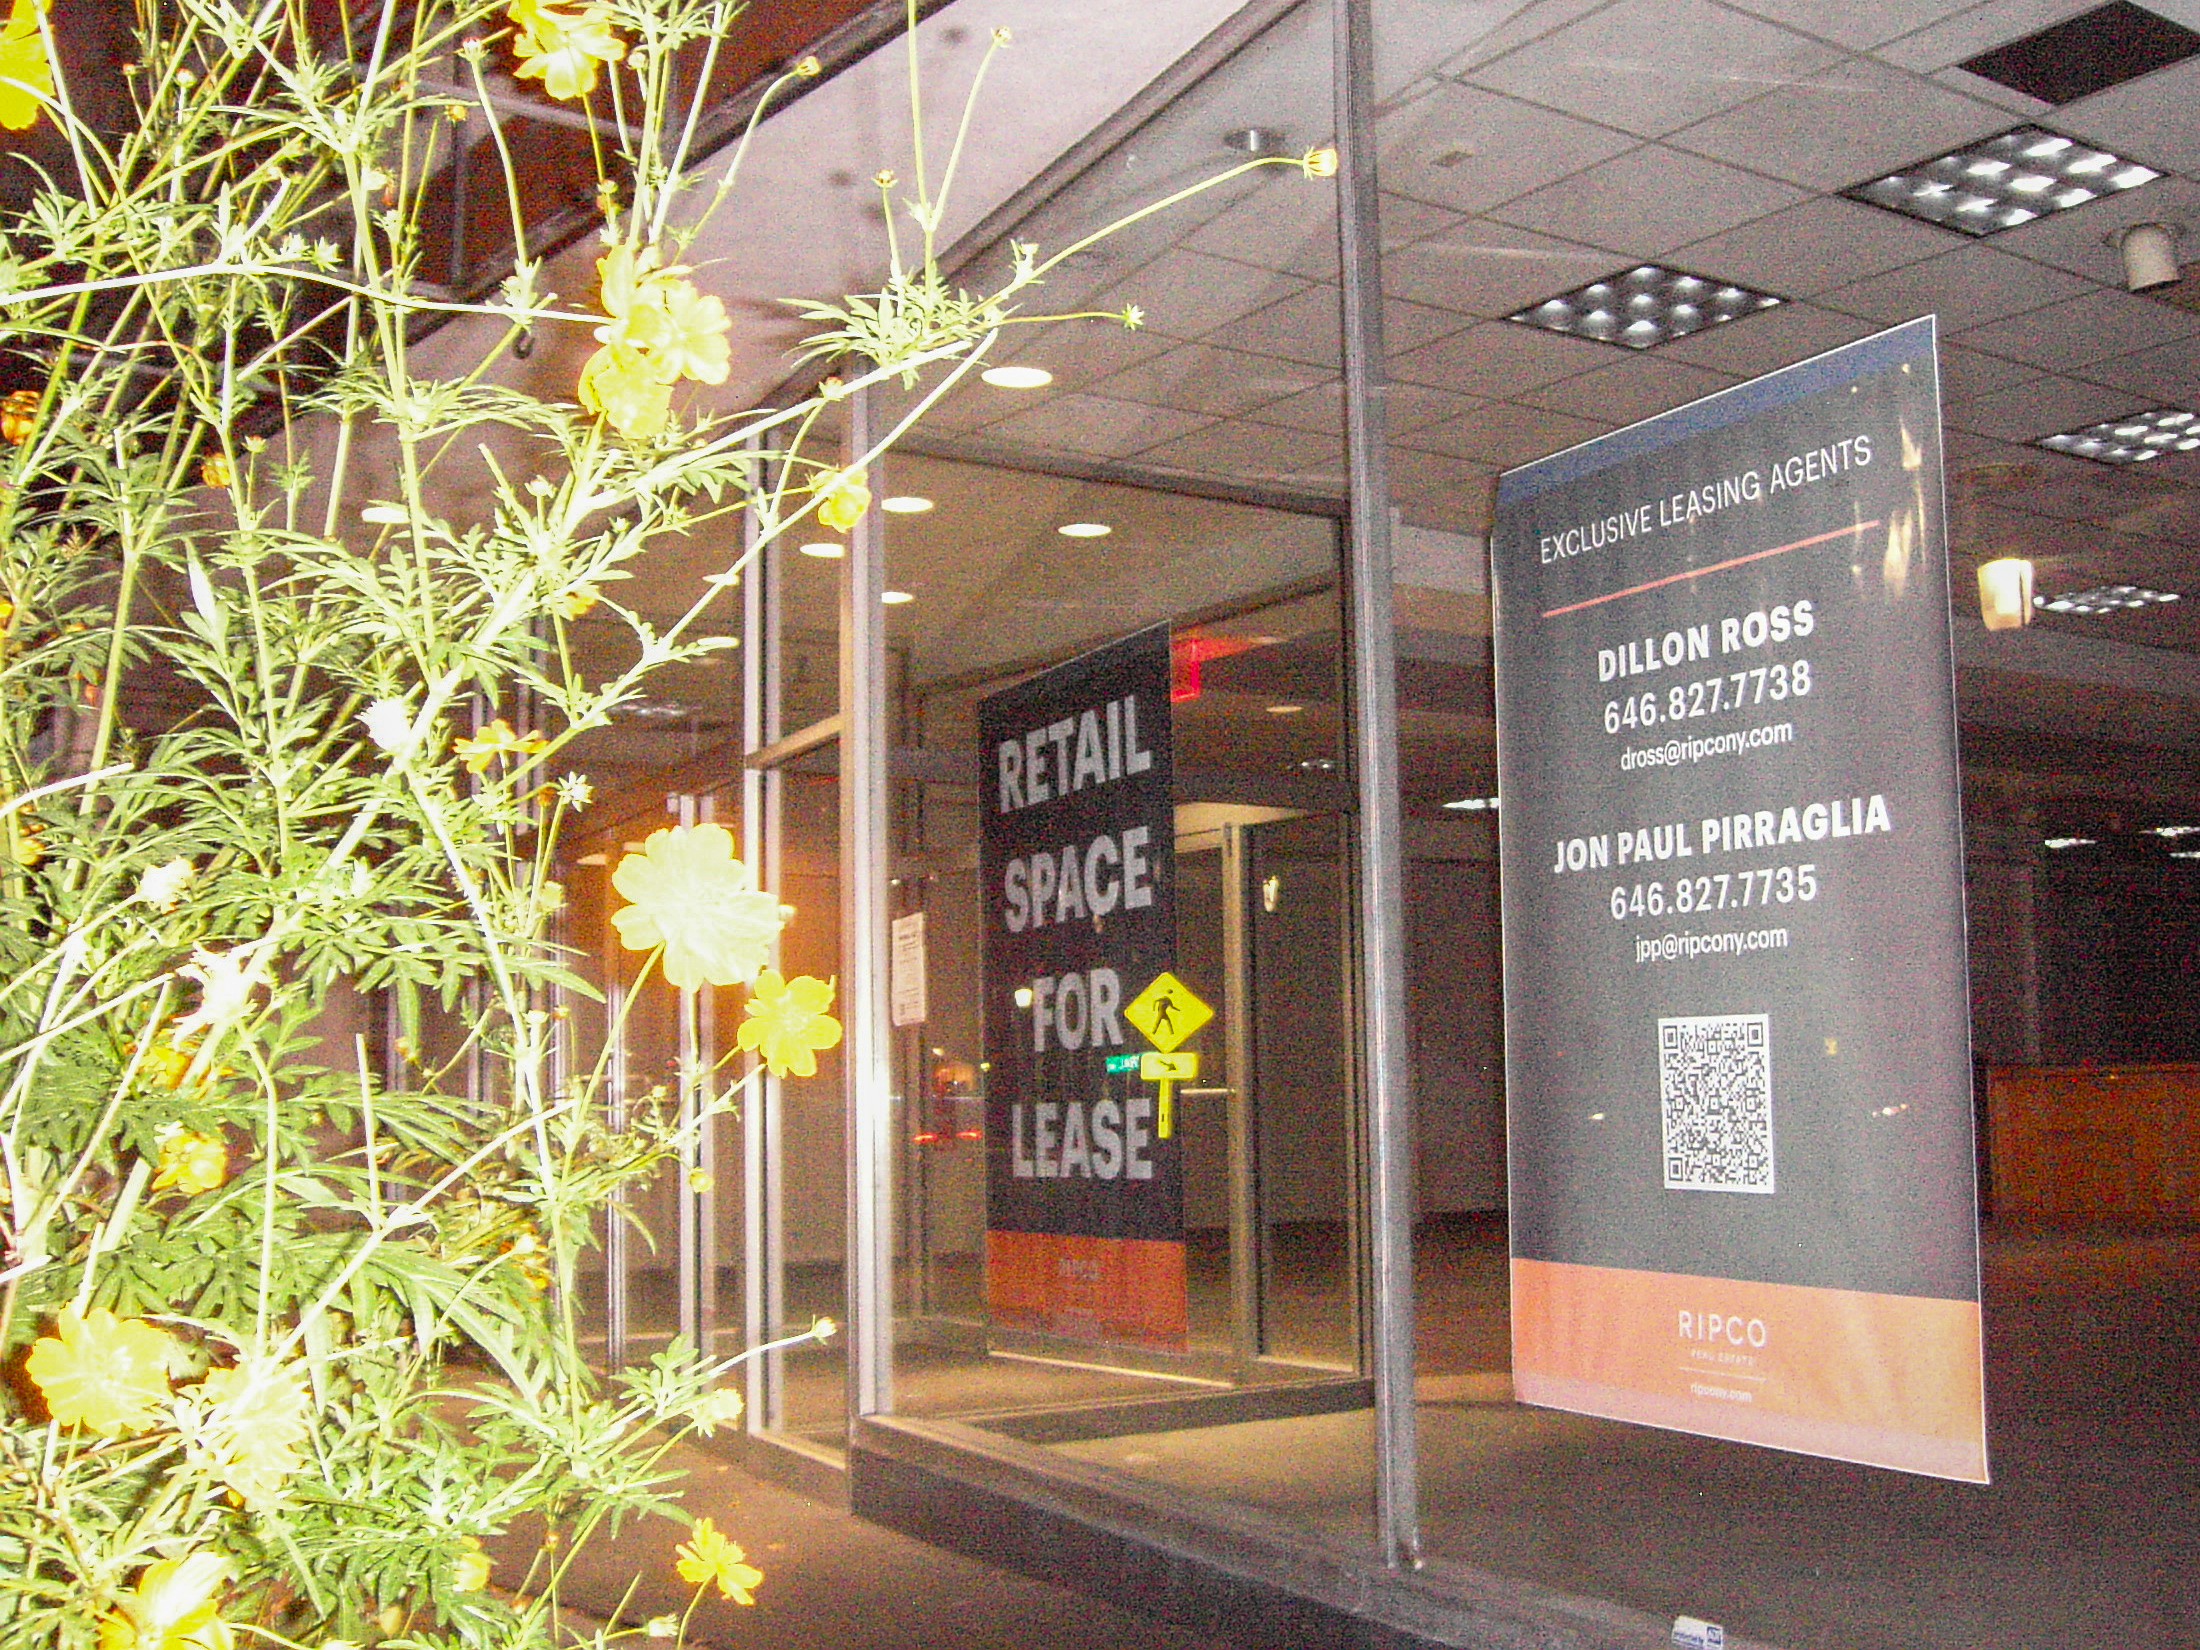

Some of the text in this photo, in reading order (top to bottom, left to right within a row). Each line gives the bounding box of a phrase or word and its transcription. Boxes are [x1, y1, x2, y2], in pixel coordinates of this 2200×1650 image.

[1540, 434, 1874, 564] EXCLUSIVE LEASING AGENTS
[1598, 599, 1815, 683] DILLON ROSS
[1603, 659, 1812, 735] 646.827.7738
[998, 694, 1152, 814] RETAIL
[1621, 722, 1793, 771] dross@ripcony.com
[1553, 793, 1892, 874] JON PAUL PIRRAGLIA
[1004, 825, 1153, 933] SPACE
[1610, 863, 1818, 921] 646.827.7735
[1635, 928, 1789, 963] jpp@ripcony.com
[1032, 967, 1124, 1052] FOR
[1012, 1097, 1153, 1180] LEASE
[1678, 1310, 1767, 1348] RIPCO
